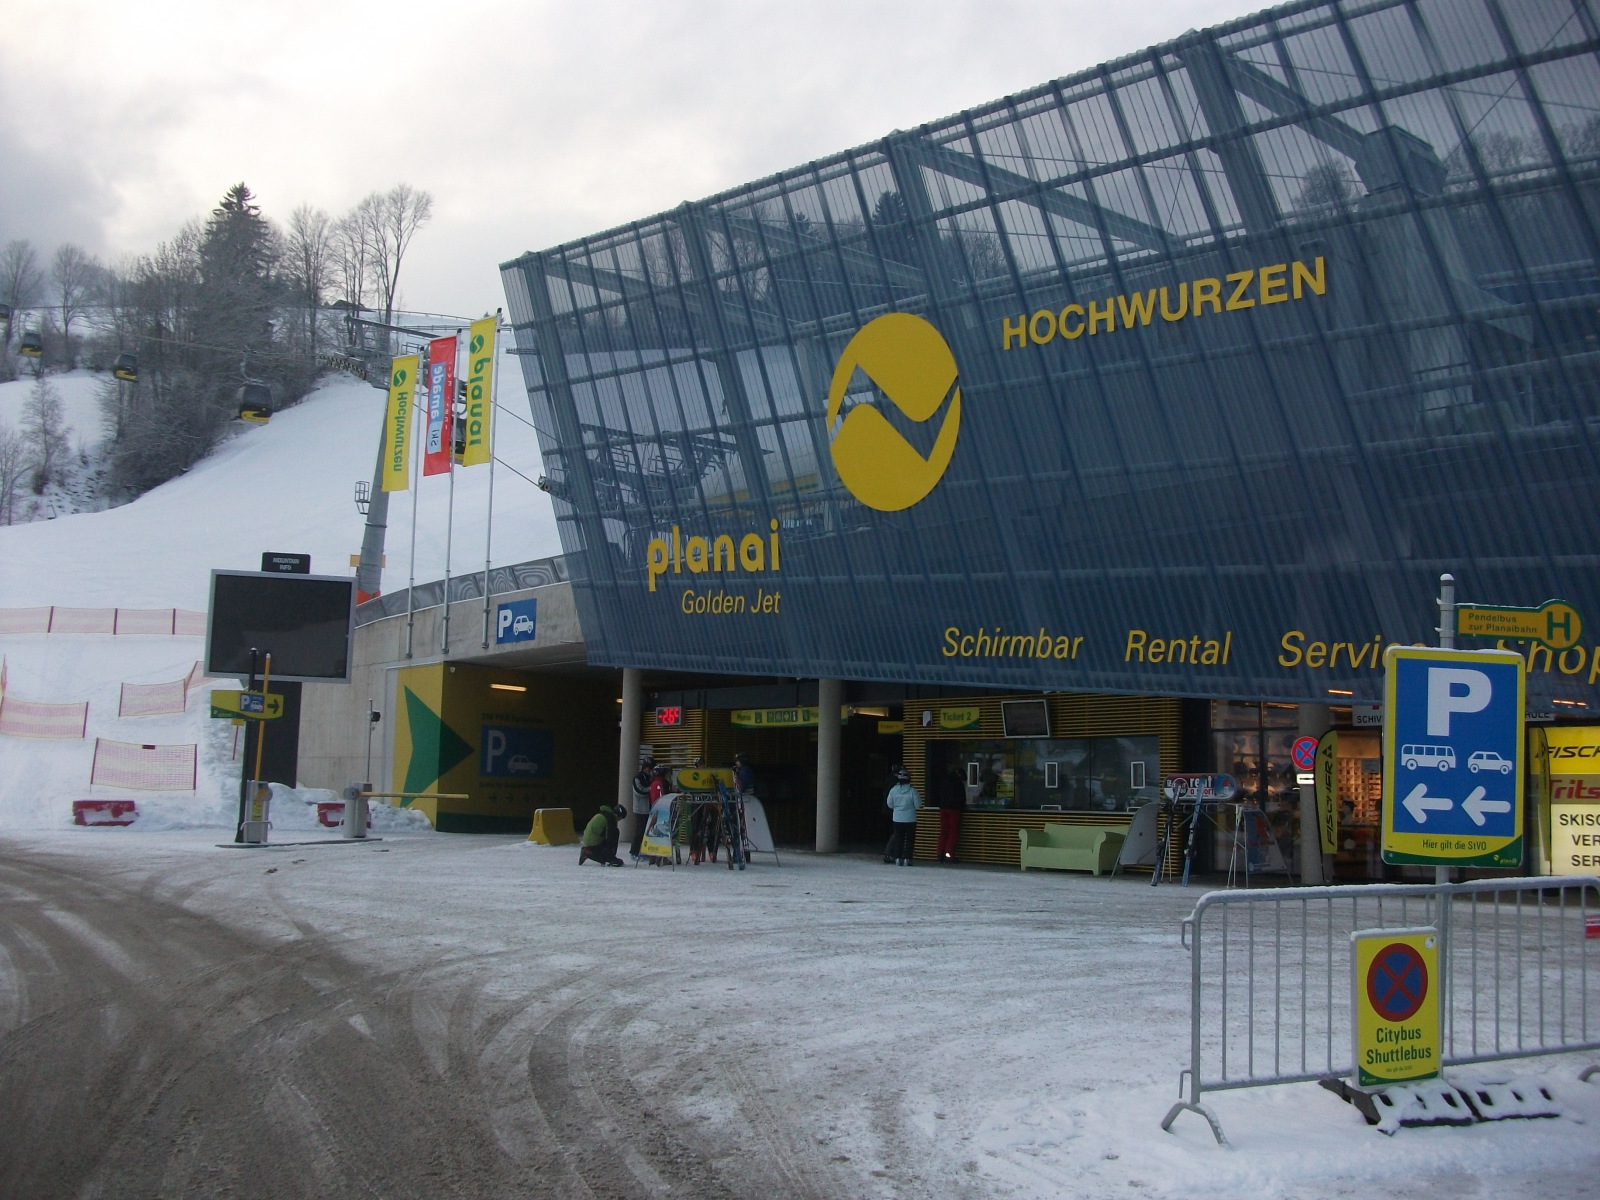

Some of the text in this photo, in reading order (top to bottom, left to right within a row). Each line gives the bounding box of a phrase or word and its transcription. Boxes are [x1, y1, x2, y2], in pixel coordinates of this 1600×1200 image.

[1003, 256, 1326, 350] HOCHWURZEN
[647, 518, 780, 592] planai
[681, 588, 781, 614] Golden Jet
[498, 609, 513, 638] P
[1468, 613, 1516, 623] Pendelbus
[1469, 623, 1538, 634] zur Planaibahn
[1547, 611, 1570, 641] H
[942, 627, 1084, 660] Schirmbar
[1125, 630, 1232, 665] Rental
[1278, 630, 1427, 669] Servi
[241, 695, 250, 710] P
[943, 712, 972, 721] Ticket 2
[1427, 667, 1492, 737] P
[487, 730, 507, 773] P
[1422, 839, 1487, 851] Hier gilt die StVO
[1376, 1025, 1422, 1045] Citybus
[1366, 1045, 1432, 1065] Shuttlebus
